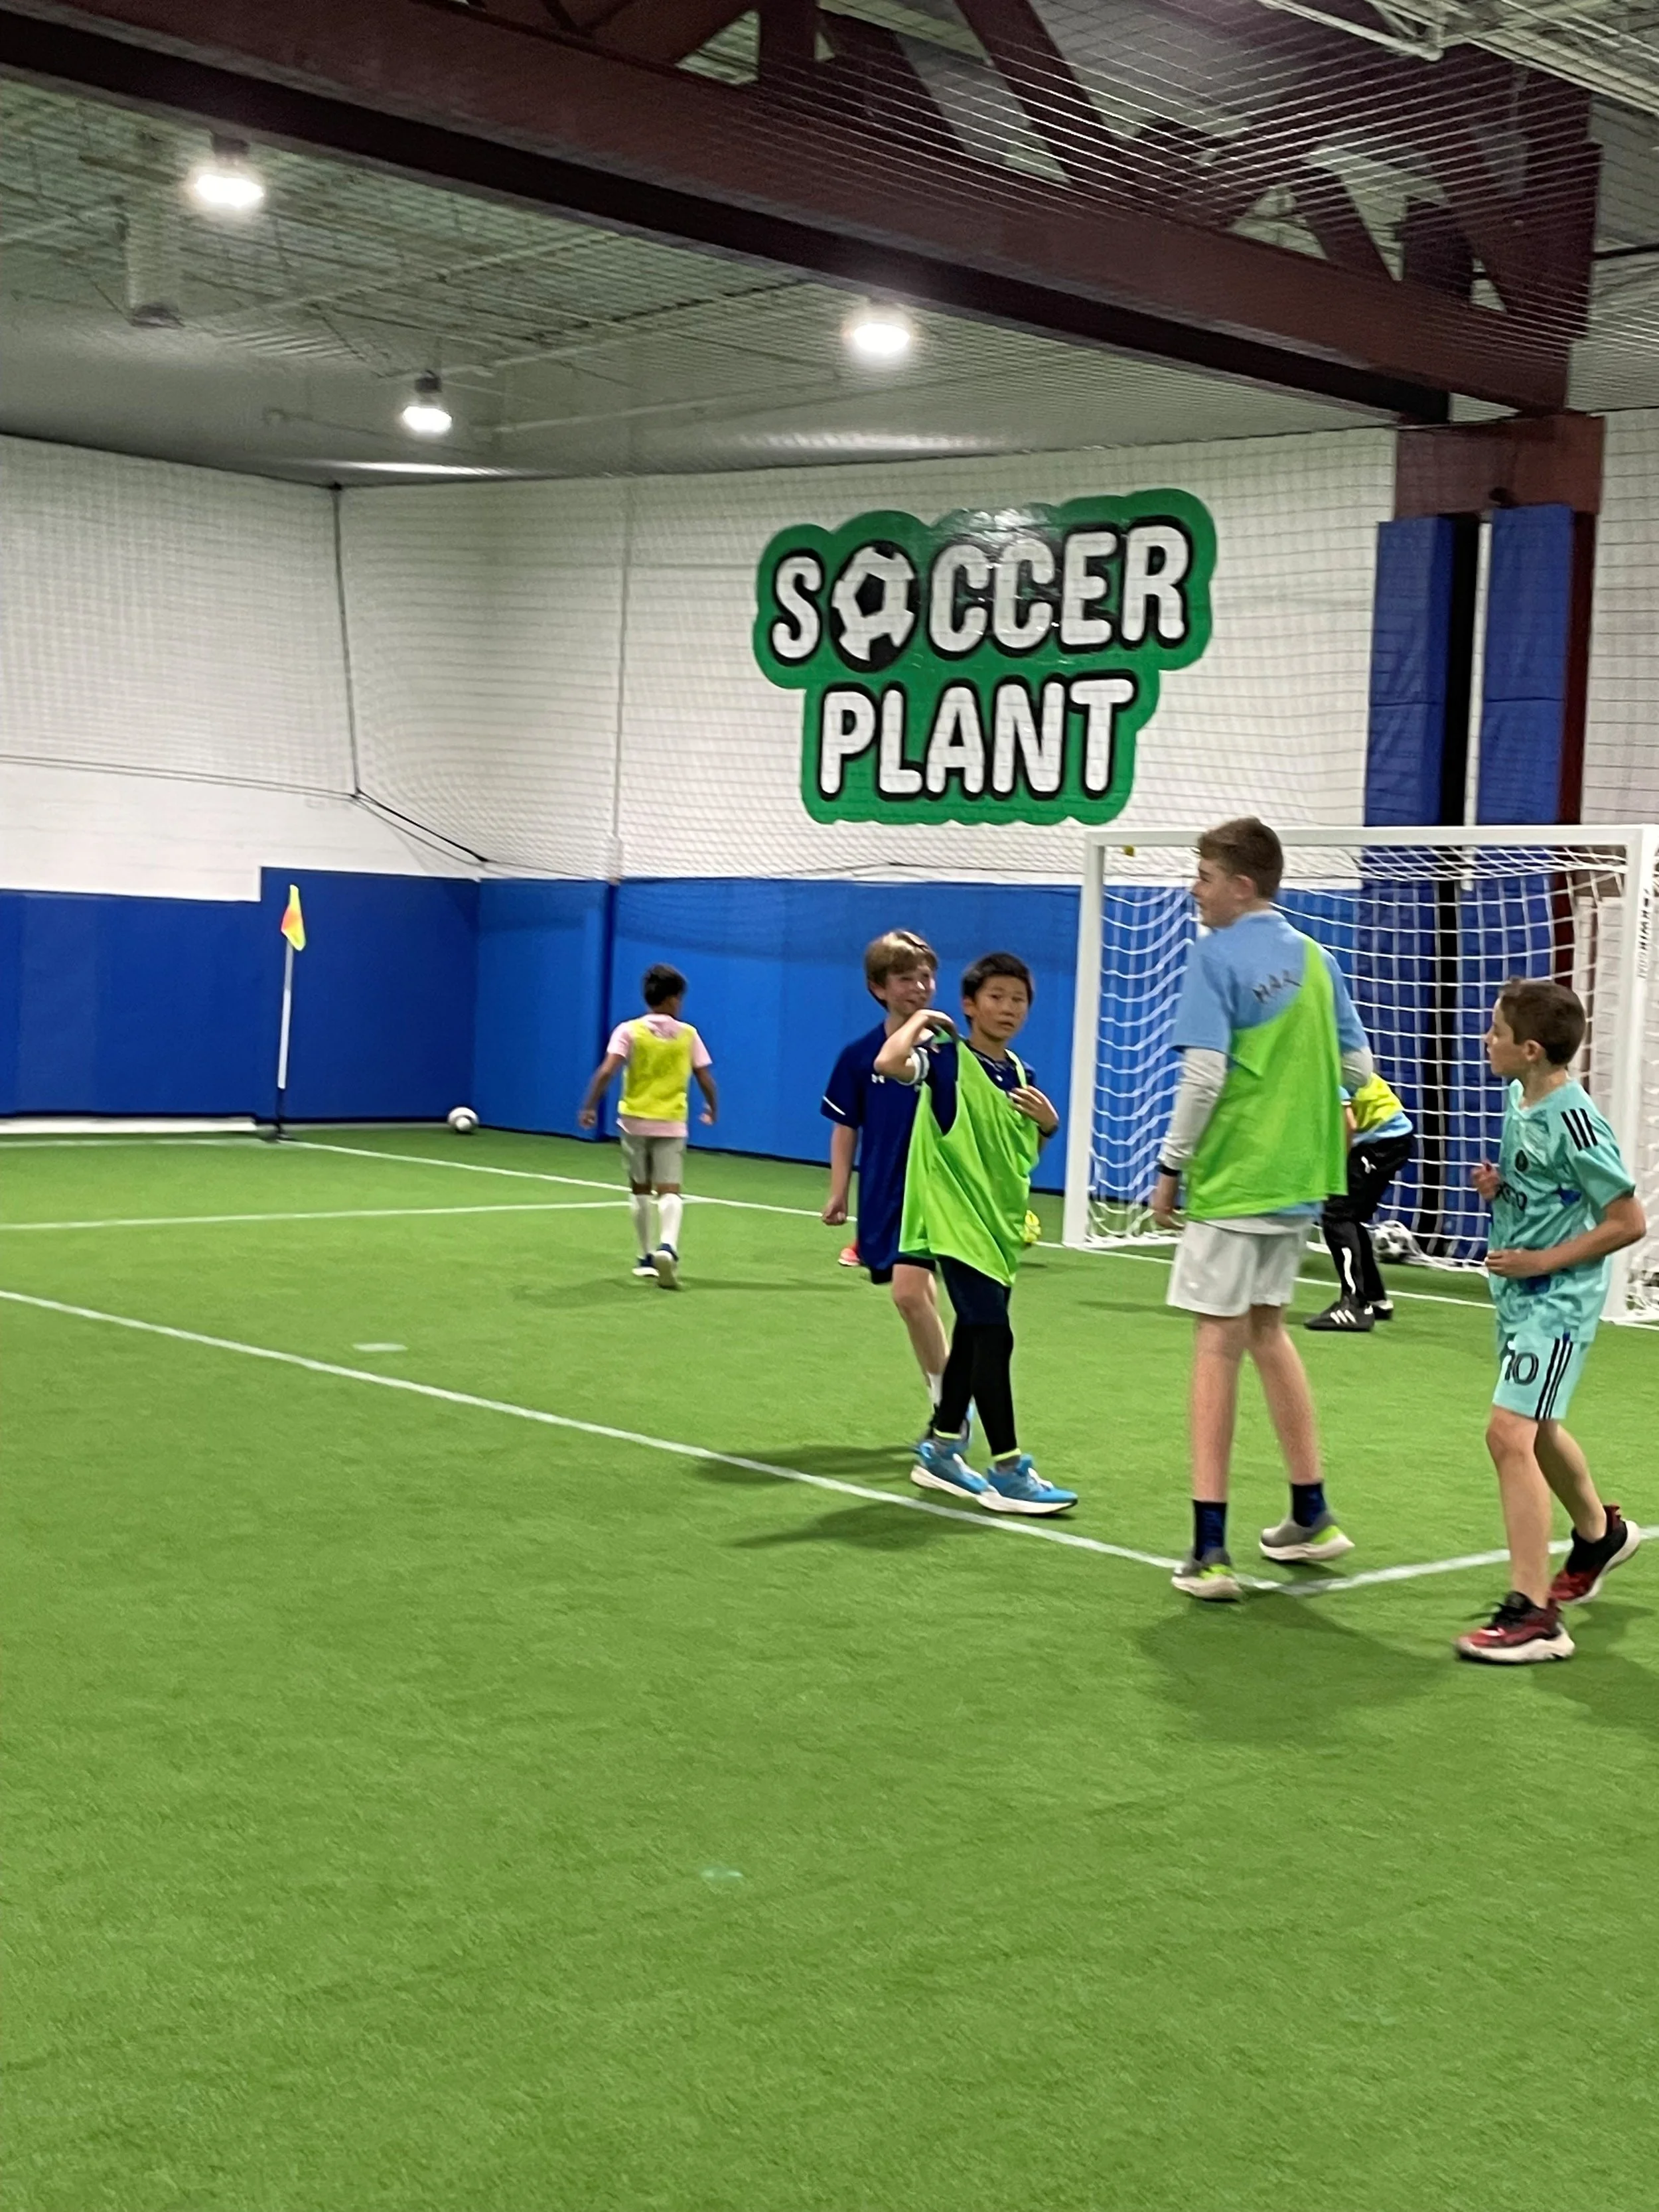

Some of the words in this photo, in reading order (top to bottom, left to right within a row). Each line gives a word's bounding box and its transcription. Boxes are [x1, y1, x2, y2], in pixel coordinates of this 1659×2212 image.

[770, 517, 1192, 671] SOCCER
[818, 670, 1138, 800] PLANT
[1504, 1350, 1540, 1386] 10
